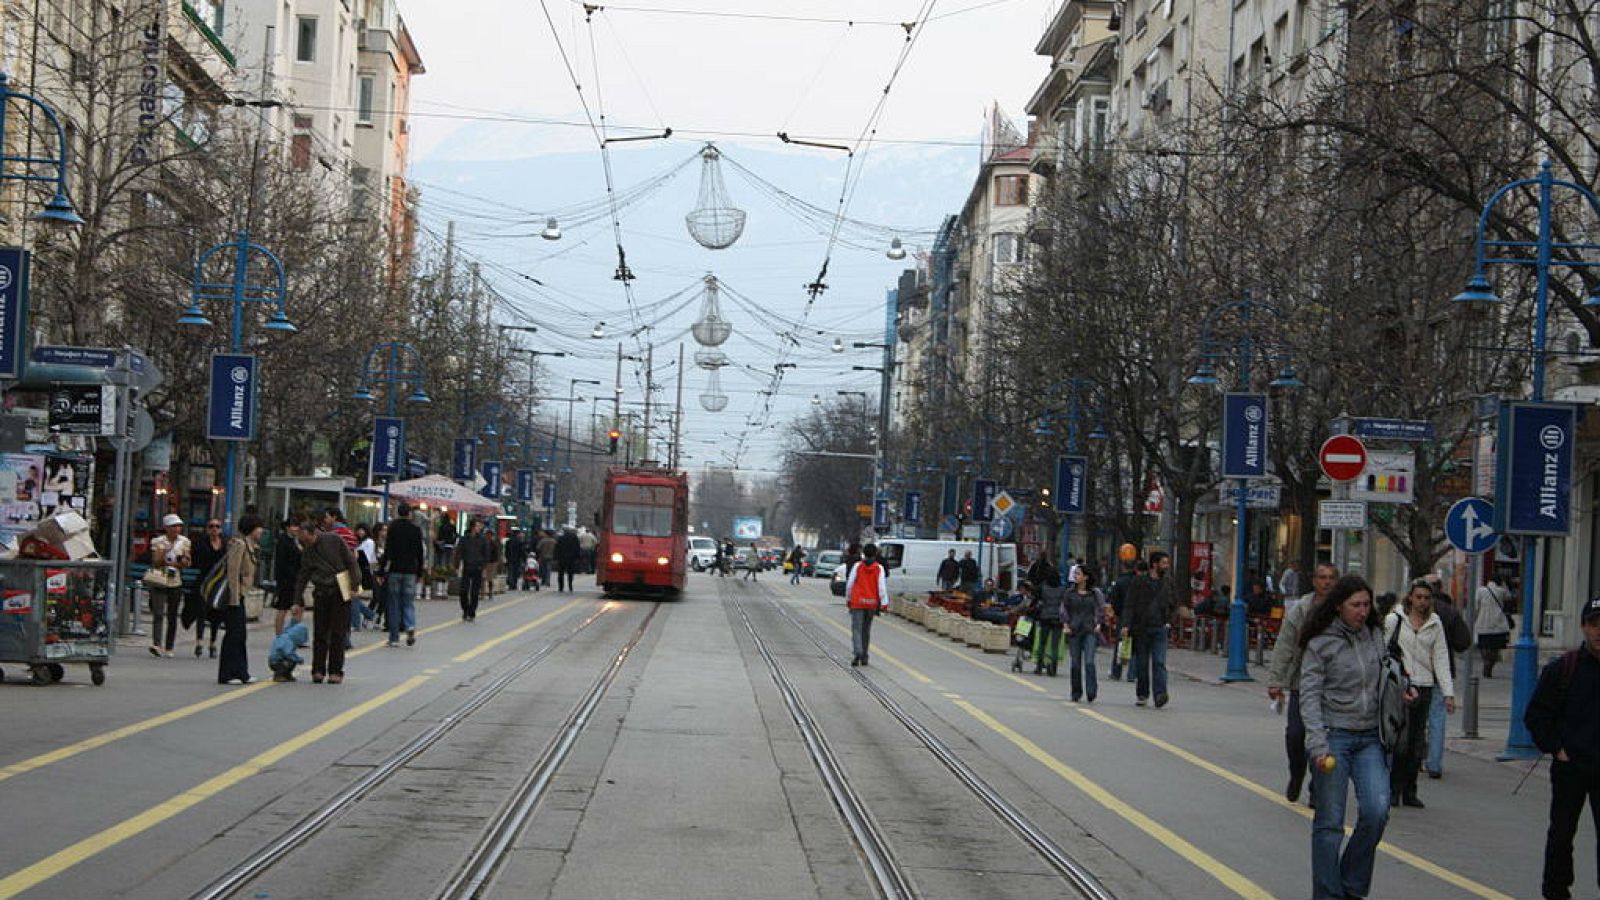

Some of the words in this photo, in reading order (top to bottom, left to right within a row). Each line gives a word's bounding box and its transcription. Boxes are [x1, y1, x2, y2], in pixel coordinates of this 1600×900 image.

[131, 22, 160, 165] Panasonic
[230, 385, 245, 429] Allianz
[386, 438, 397, 468] Allianz
[1245, 425, 1258, 467] Allianz
[1070, 477, 1079, 507] Allianz
[1539, 453, 1559, 519] Allianz
